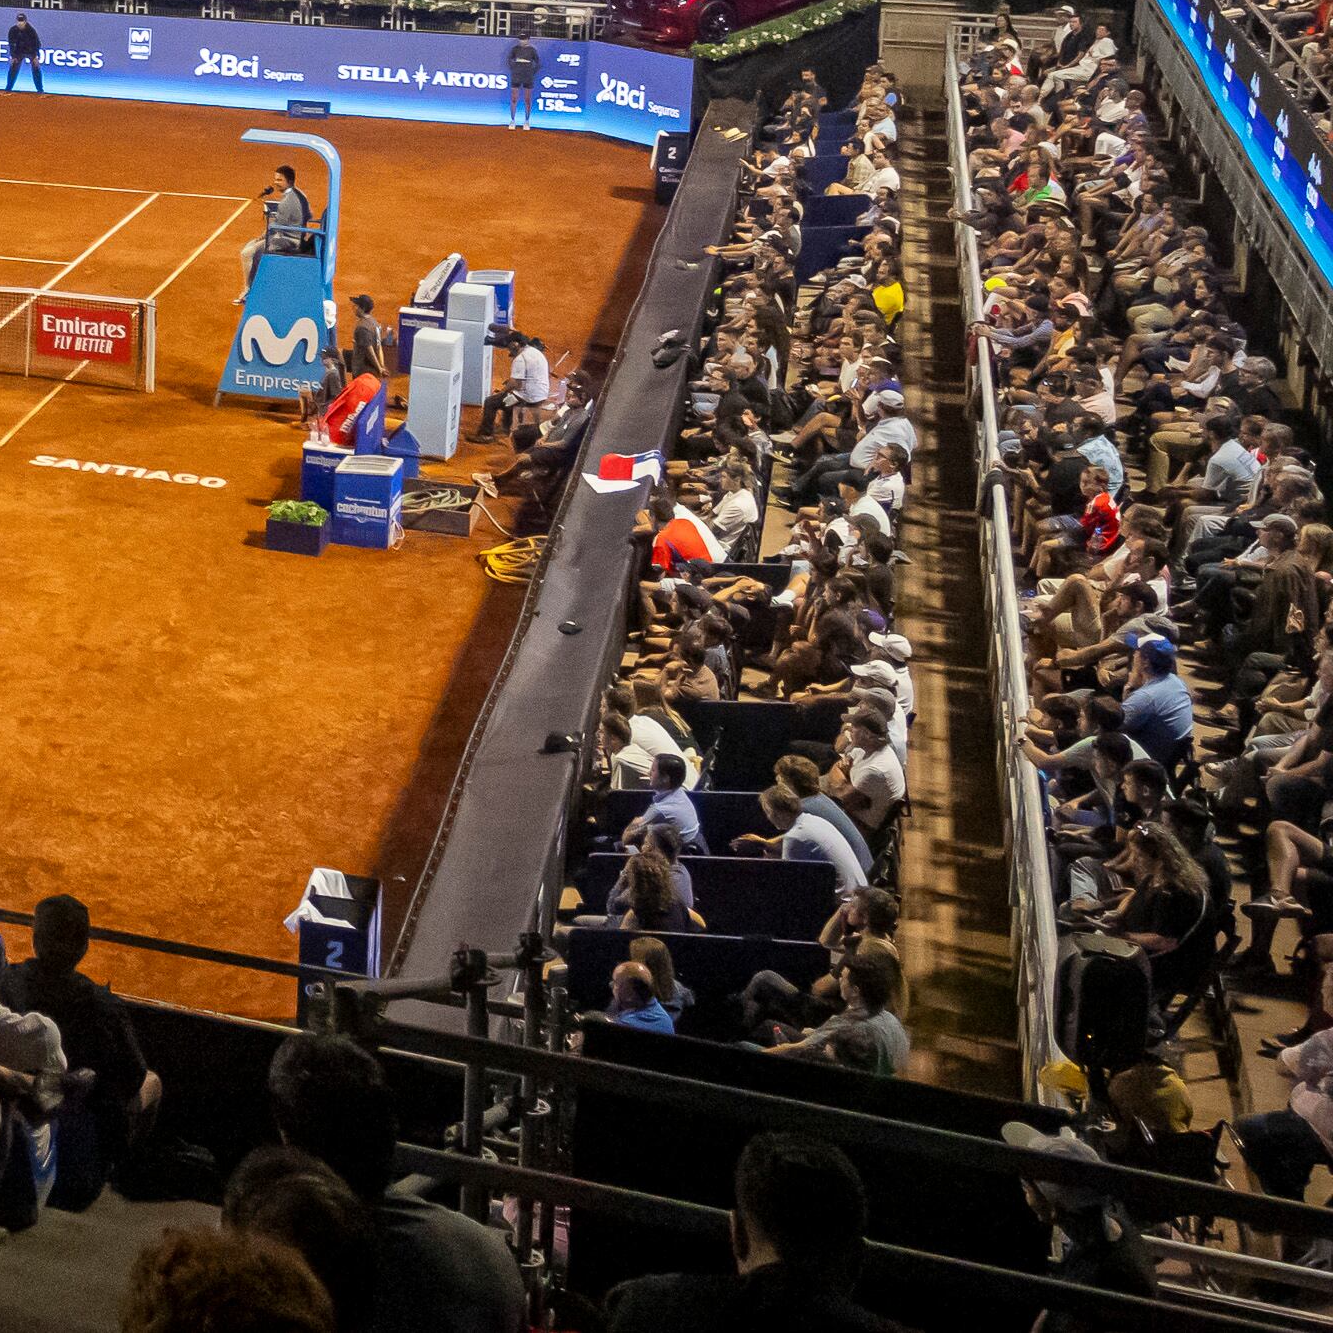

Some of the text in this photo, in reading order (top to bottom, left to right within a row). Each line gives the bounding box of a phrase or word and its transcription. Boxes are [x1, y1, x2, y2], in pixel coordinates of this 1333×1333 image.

[221, 54, 305, 82] Bci Seguros
[338, 64, 508, 89] STELLA ARTOIS
[616, 81, 680, 119] Bci Seguros
[668, 146, 677, 159] 2
[42, 314, 126, 339] Emirates
[54, 336, 114, 355] FLY BETTER
[29, 455, 227, 488] SANTIAGO
[325, 940, 343, 968] 2
